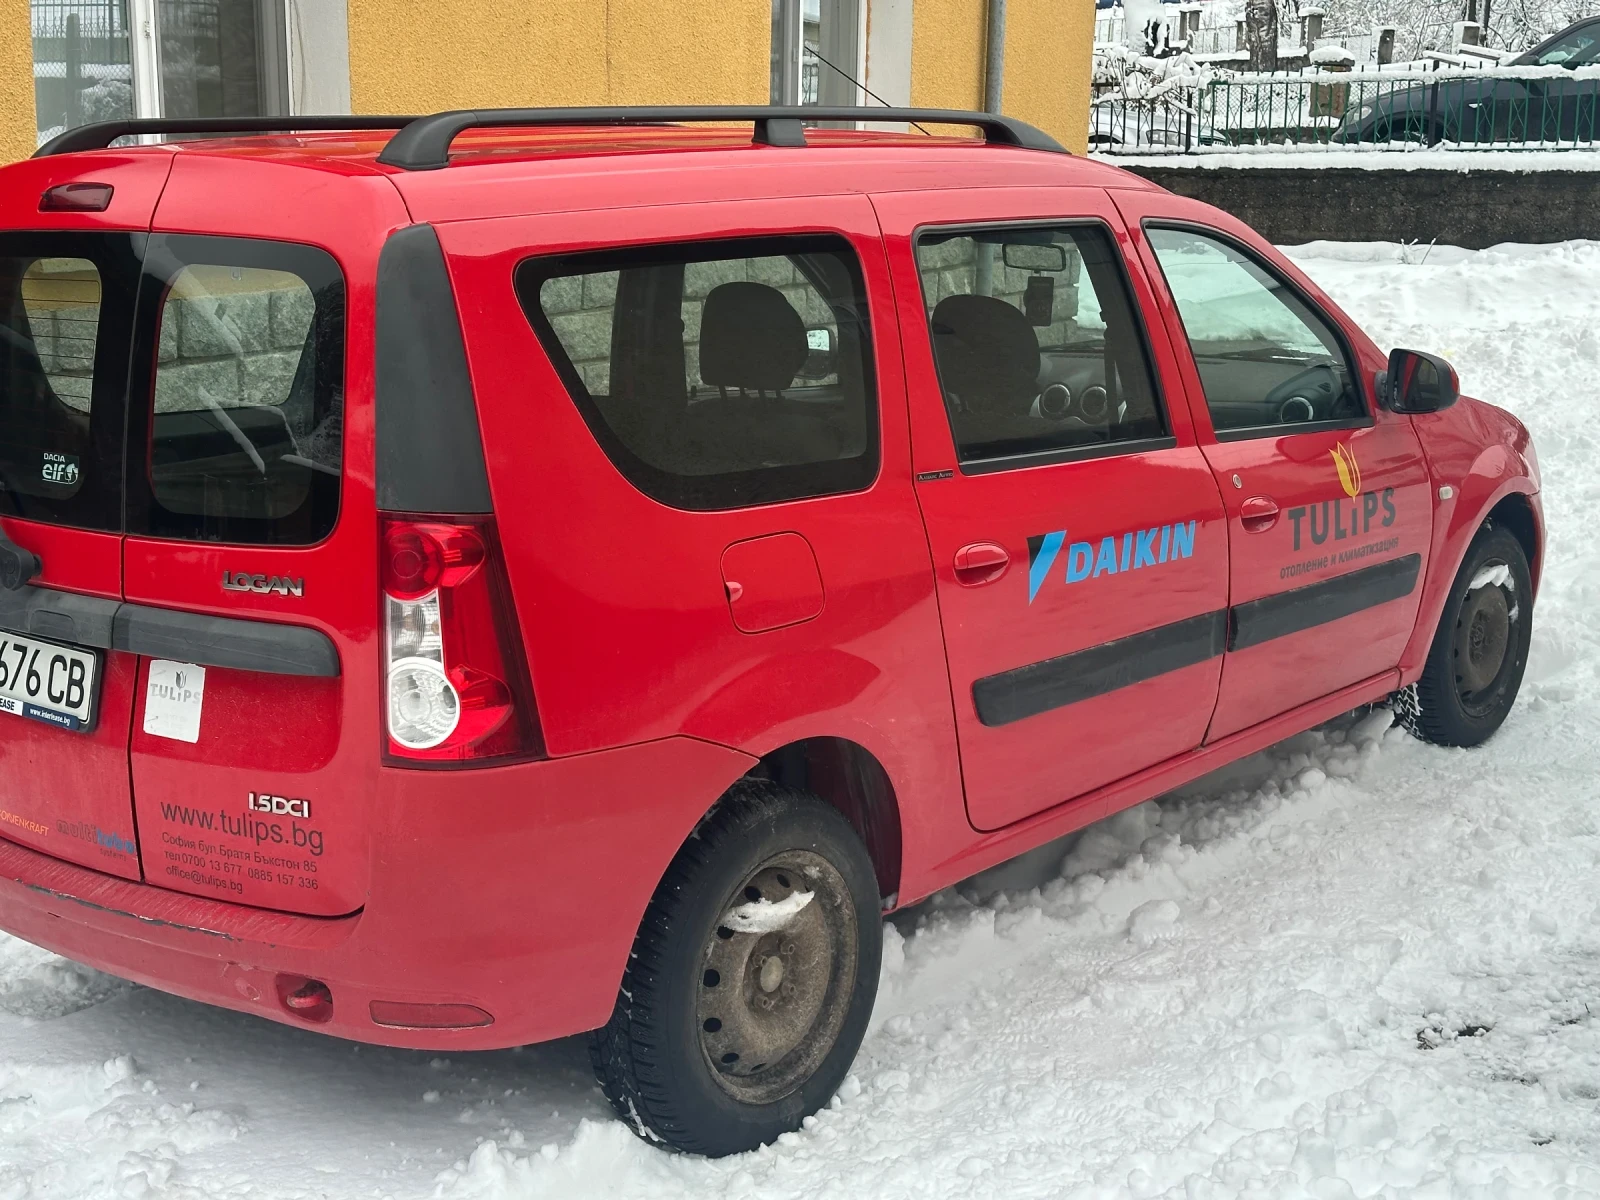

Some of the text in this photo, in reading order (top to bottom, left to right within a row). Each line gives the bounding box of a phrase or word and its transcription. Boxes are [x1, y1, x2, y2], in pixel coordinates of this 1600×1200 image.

[42, 463, 65, 481] elf
[43, 452, 65, 462] DACIA
[1065, 520, 1196, 584] DAIKIN
[1280, 537, 1399, 579] отопление и климатизация
[222, 570, 304, 597] LOGAN
[47, 654, 85, 709] CB
[29, 707, 71, 726] www.interlease.bg
[0, 809, 49, 837] ONNENKRAFT
[160, 801, 324, 857] www.tulips.bg
[162, 832, 195, 849] София
[254, 851, 300, 870] Бъкстон
[303, 860, 318, 873] 85
[166, 865, 243, 895] office@tulips.bg
[209, 860, 221, 871] 13
[223, 862, 242, 876] 677
[247, 867, 273, 882] 0885
[276, 873, 295, 886] 157
[298, 876, 319, 890] 336
